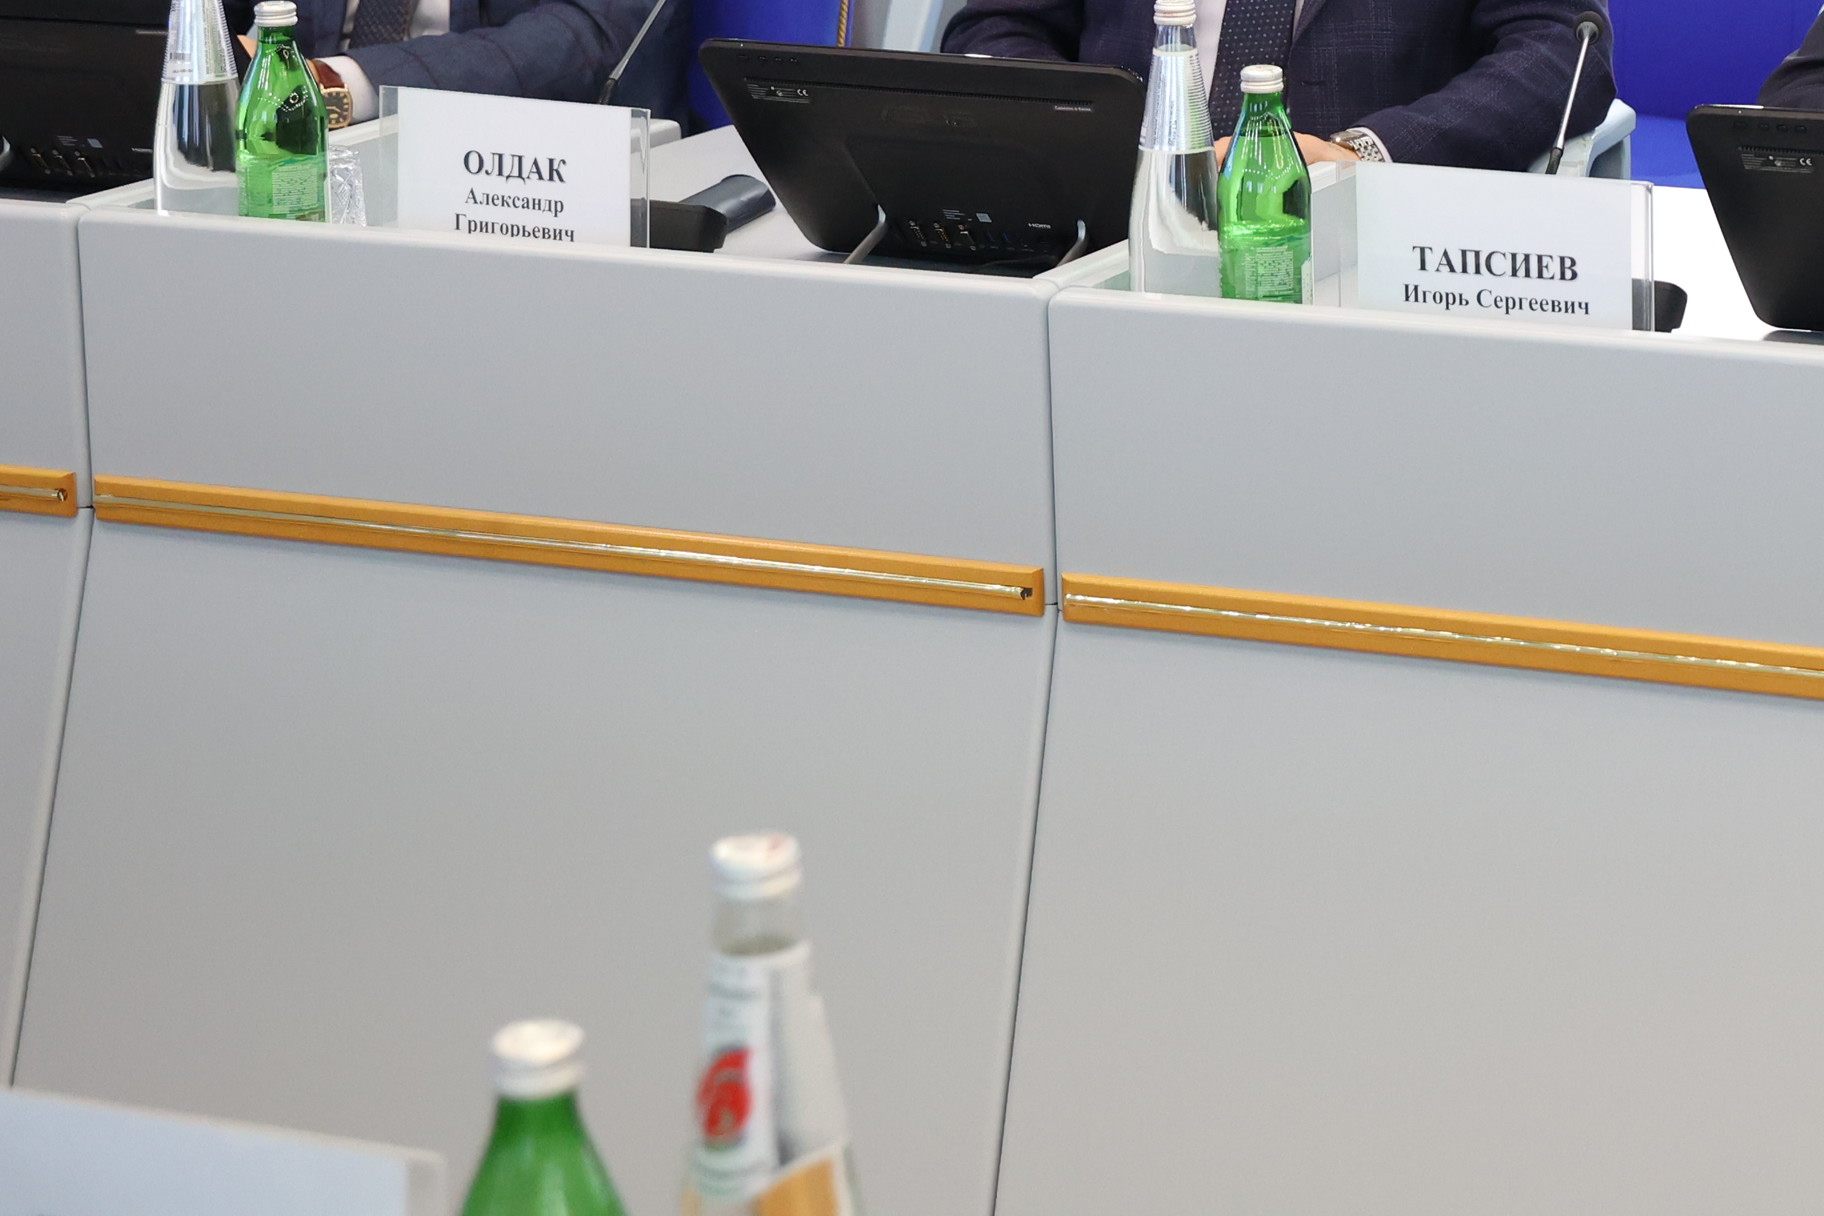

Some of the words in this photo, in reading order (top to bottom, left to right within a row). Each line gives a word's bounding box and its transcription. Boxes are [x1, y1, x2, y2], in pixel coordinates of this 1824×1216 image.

[463, 149, 567, 184] ОЛДАК
[464, 186, 565, 217] Александр
[454, 212, 576, 242] Григорьевич
[1412, 245, 1578, 282] ТАПСИЕВ
[1403, 283, 1470, 311] Игорь
[1476, 288, 1591, 315] Сергеевич
